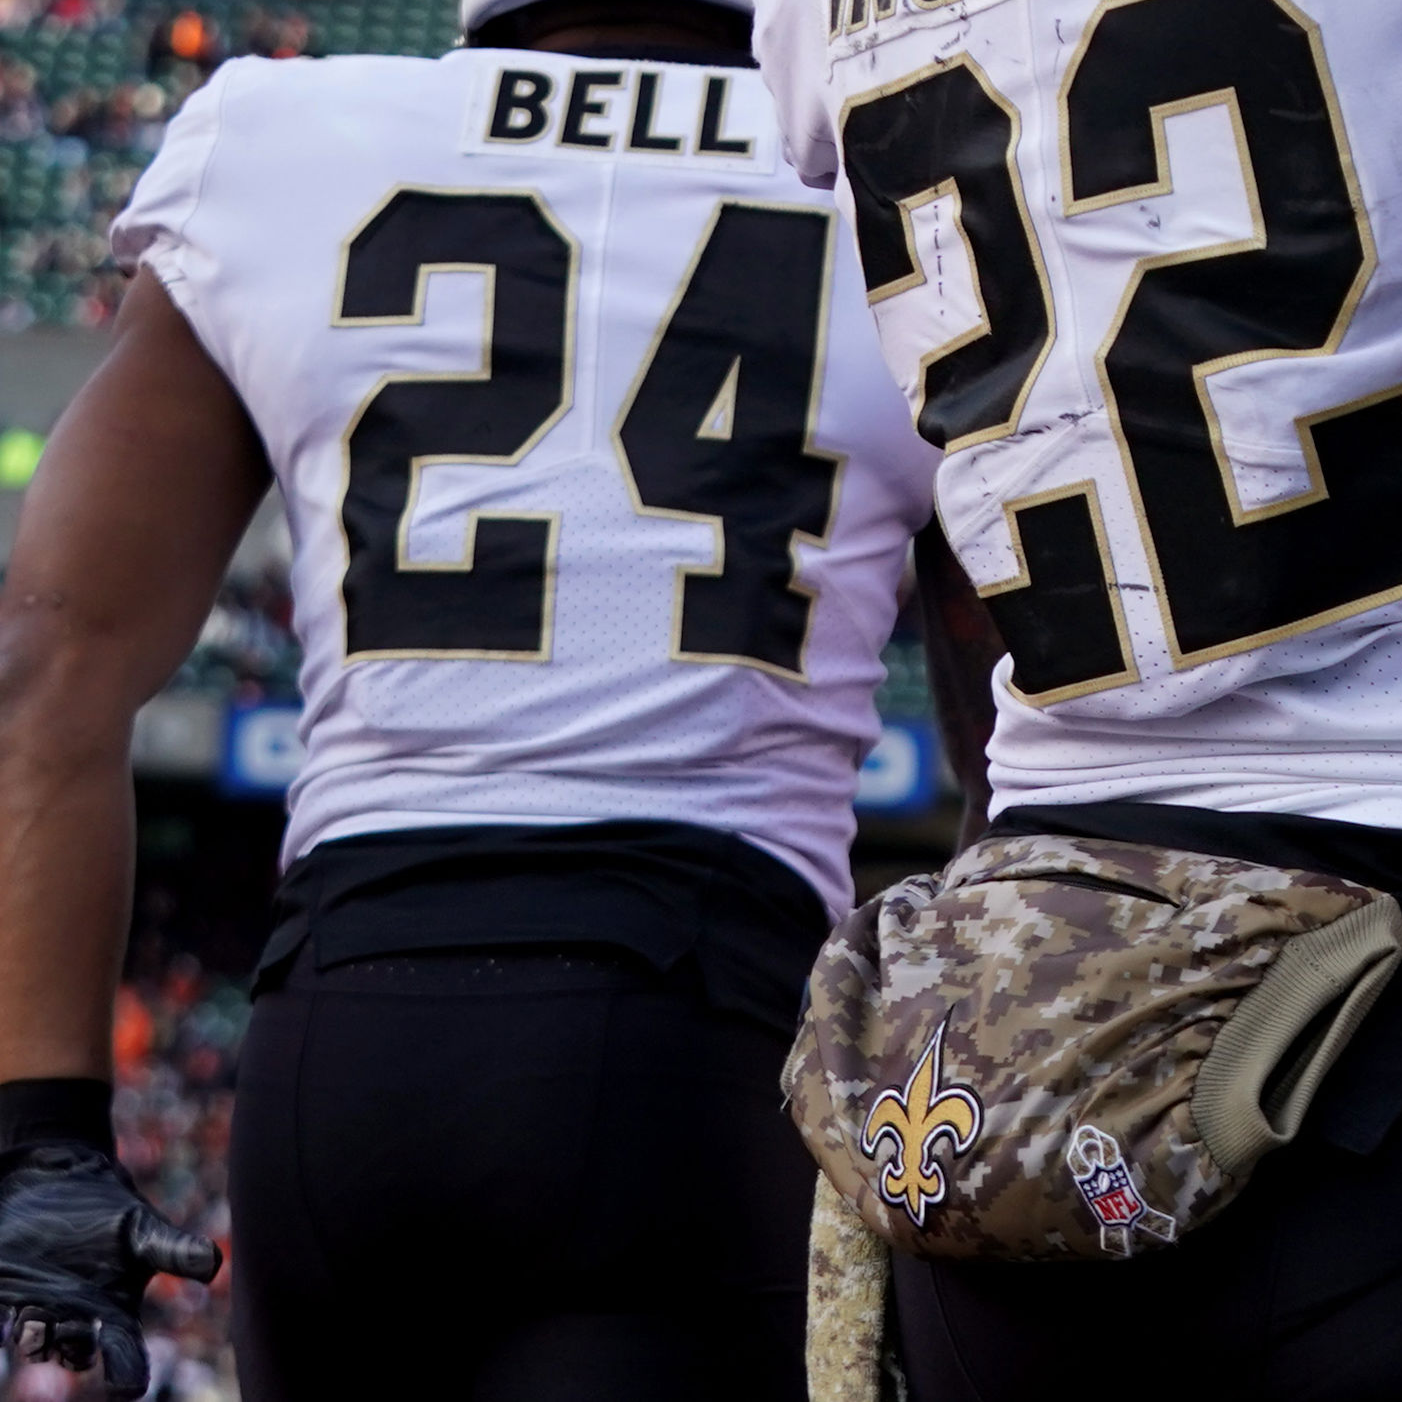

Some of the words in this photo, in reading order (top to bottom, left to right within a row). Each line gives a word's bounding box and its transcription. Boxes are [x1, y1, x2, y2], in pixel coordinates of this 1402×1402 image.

[484, 69, 755, 157] BELL
[330, 184, 848, 683] 24
[1093, 1189, 1139, 1221] NFL
